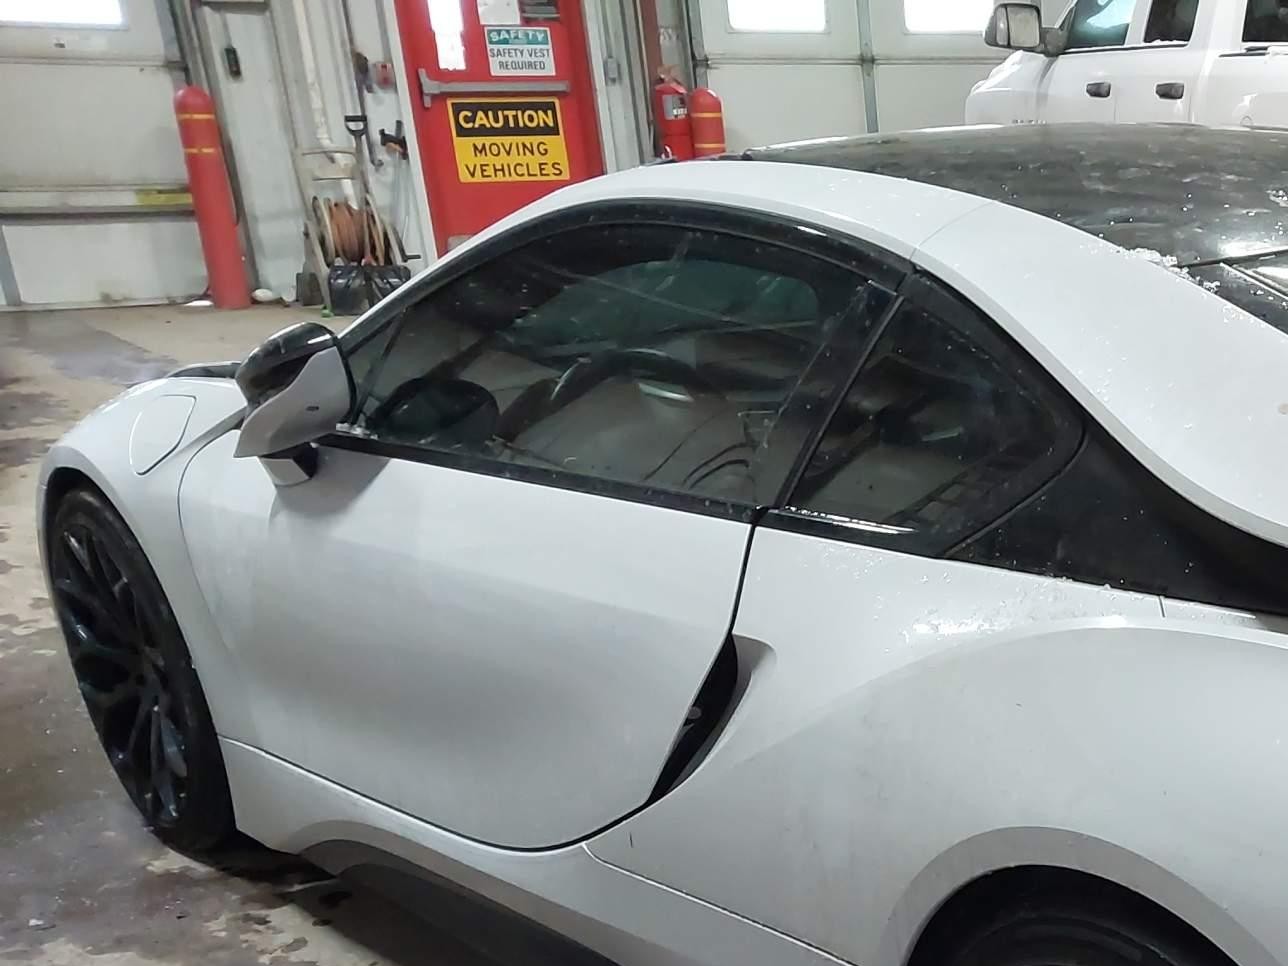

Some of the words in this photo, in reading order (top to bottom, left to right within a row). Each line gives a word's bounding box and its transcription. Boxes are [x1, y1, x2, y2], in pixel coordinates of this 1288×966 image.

[489, 30, 545, 42] SAFETY
[489, 48, 524, 58] SAFETY
[526, 48, 551, 58] VEST
[498, 60, 546, 71] REQUIRED
[458, 110, 555, 129] CAUTION
[472, 142, 549, 157] MOVING
[465, 162, 563, 179] VEHICLES
